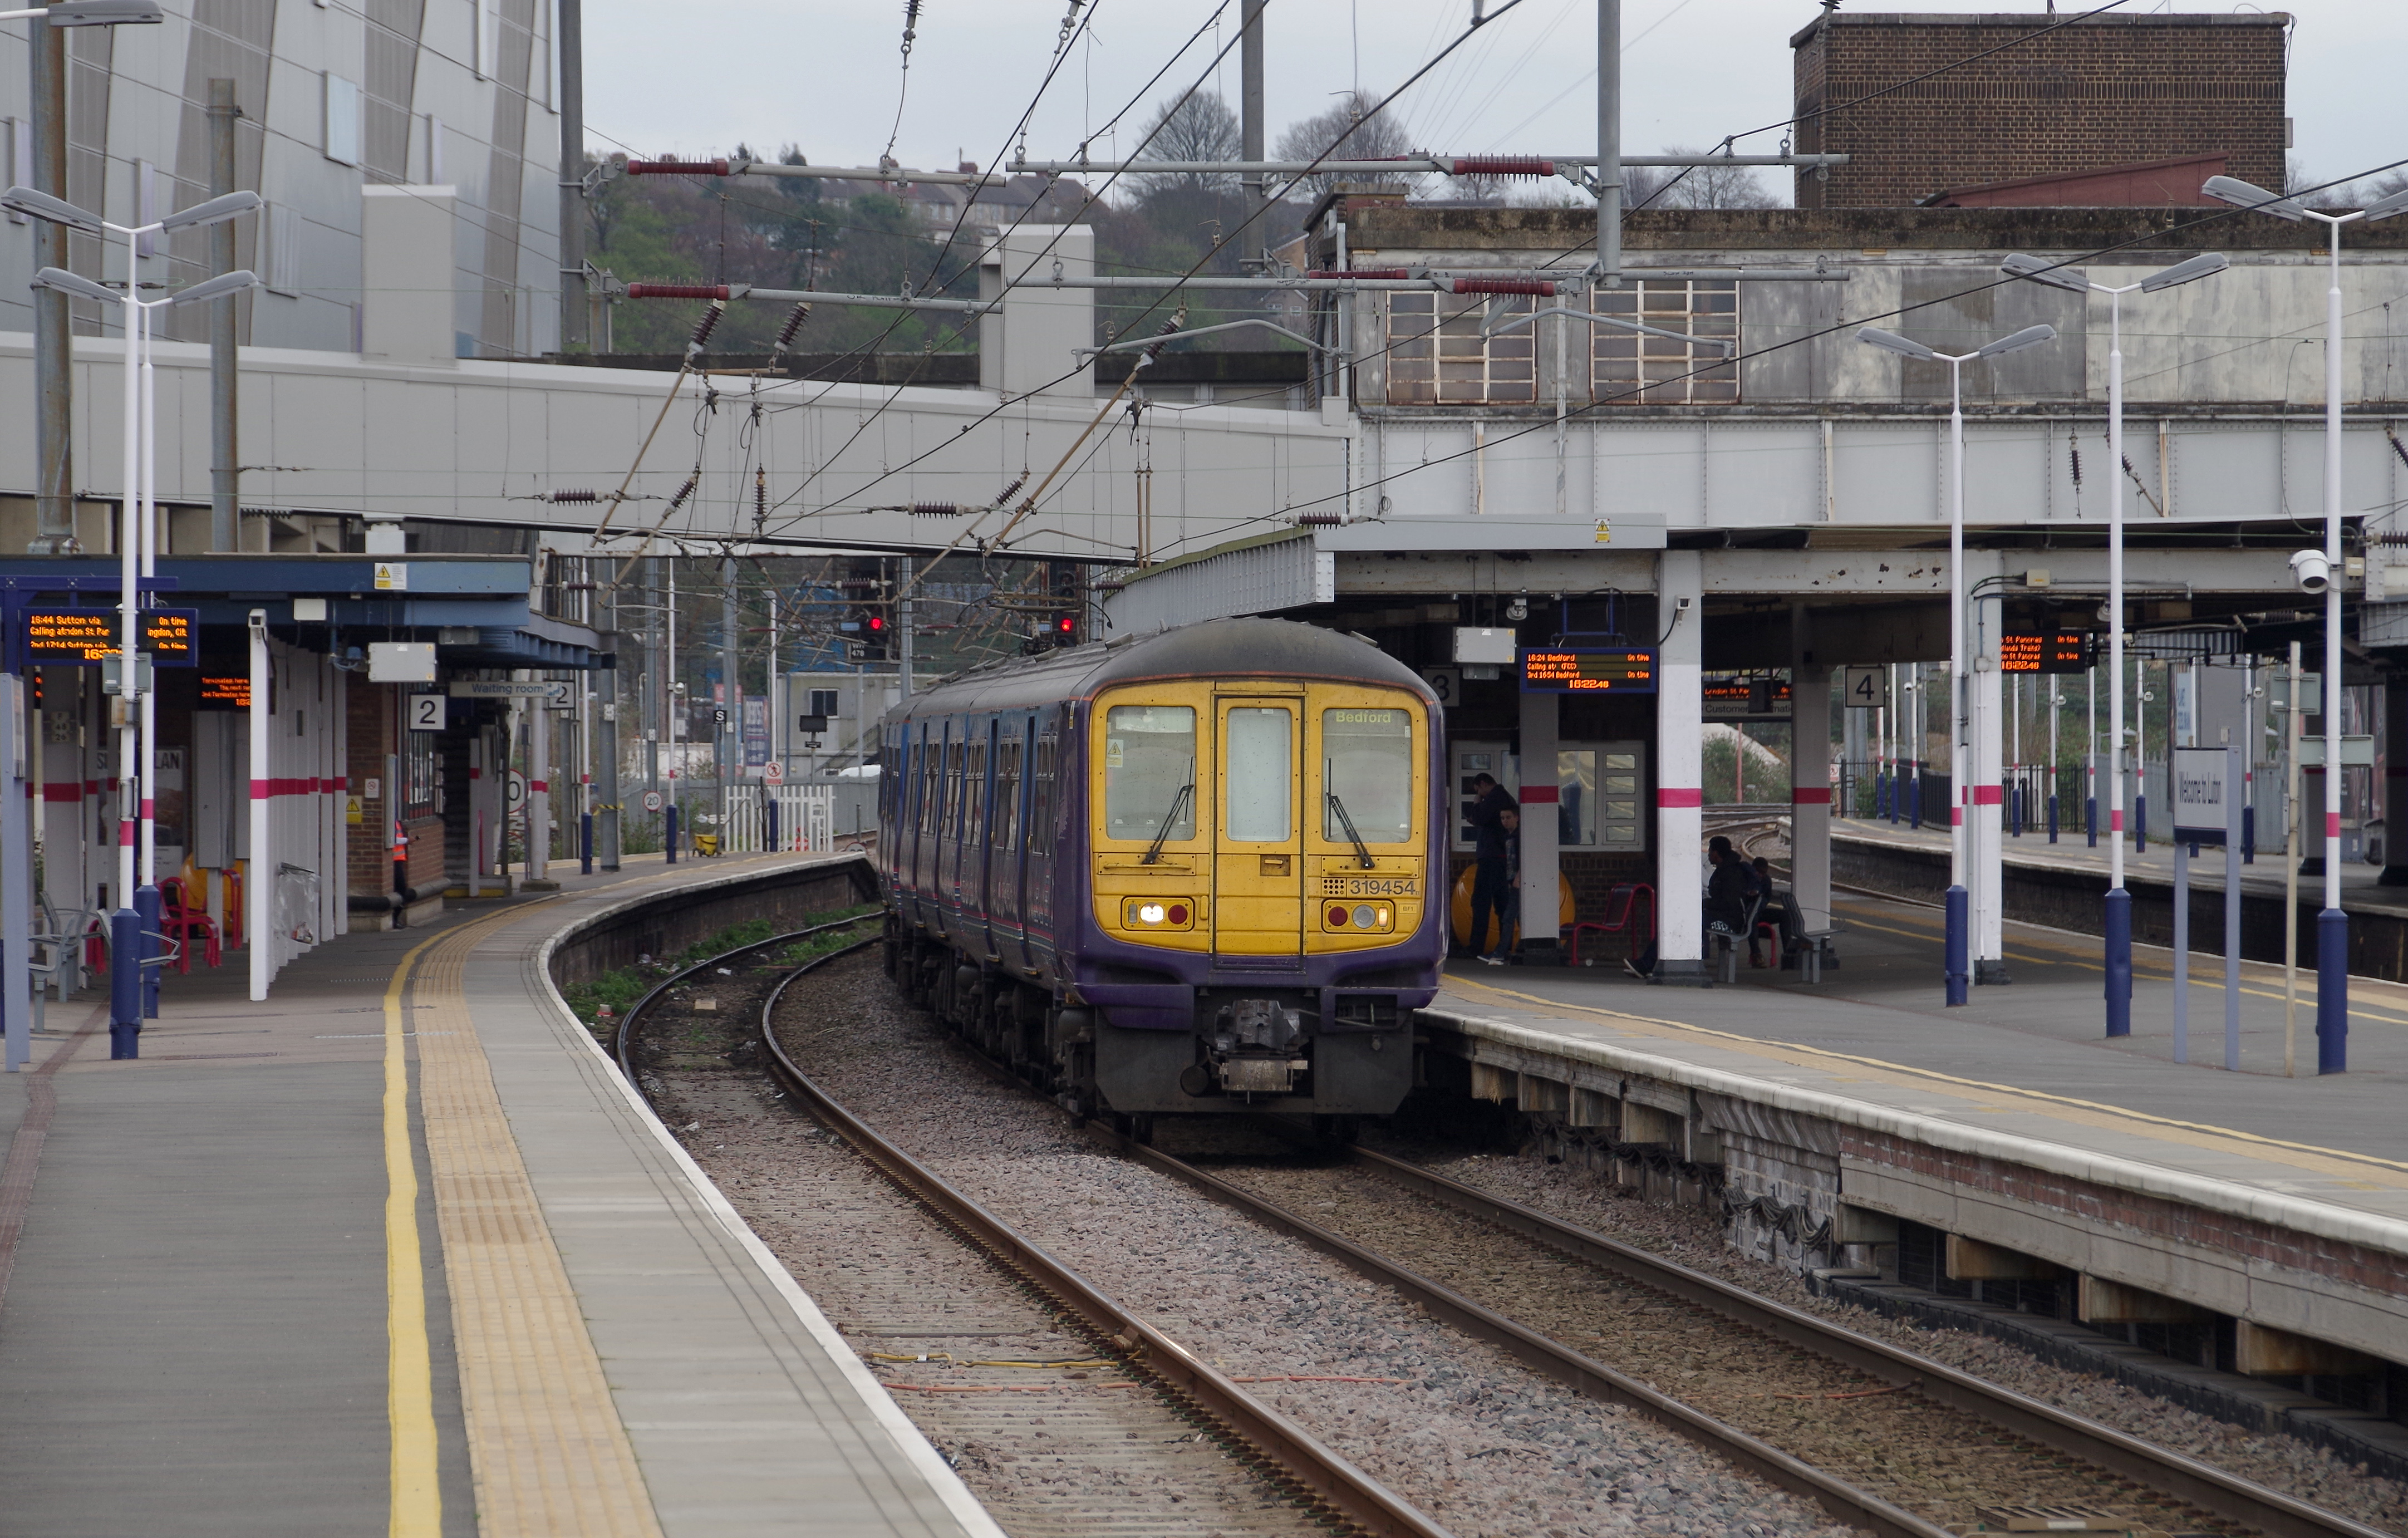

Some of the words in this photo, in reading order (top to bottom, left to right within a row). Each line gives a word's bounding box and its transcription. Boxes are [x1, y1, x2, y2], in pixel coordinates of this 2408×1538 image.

[31, 616, 54, 624] 16:44
[56, 616, 86, 625] Sutton
[88, 616, 101, 625] via
[159, 616, 169, 626] On
[170, 616, 188, 626] time
[30, 627, 55, 637] Calling
[472, 683, 512, 694] Waiting
[1432, 675, 1449, 701] 3
[1856, 674, 1875, 700] 4
[420, 700, 436, 724] 2
[1706, 705, 1748, 713] Customer
[715, 711, 725, 721] S
[1336, 711, 1391, 723] Bedford
[646, 797, 659, 805] 20
[1350, 879, 1416, 895] 319454
